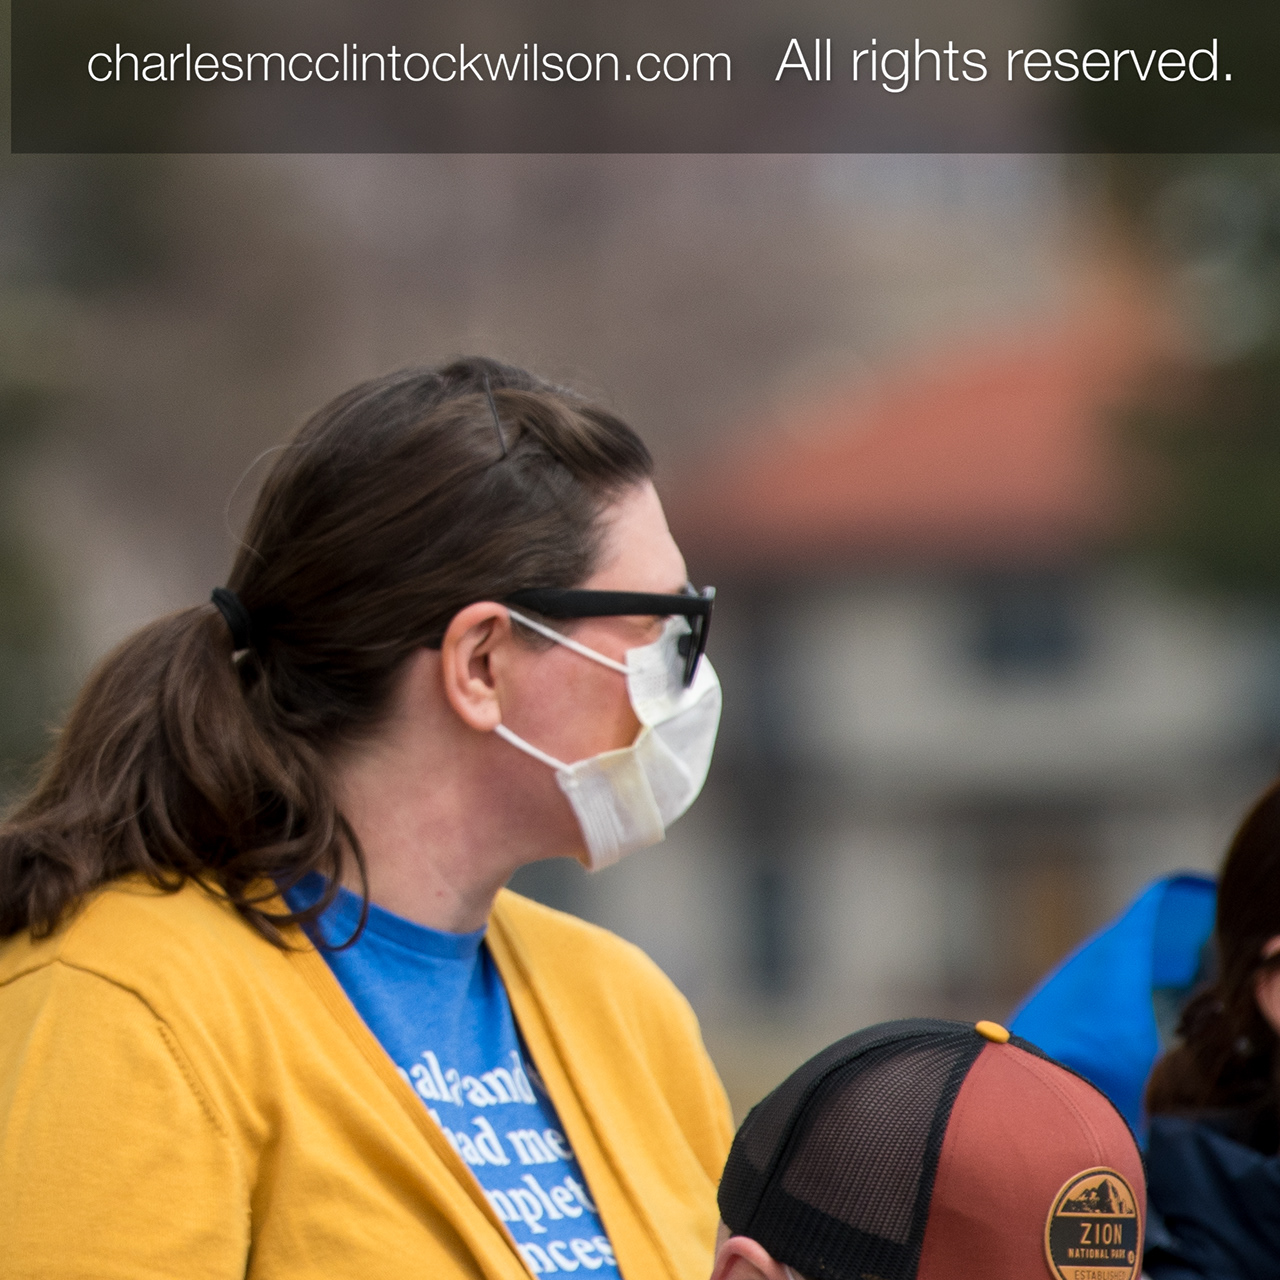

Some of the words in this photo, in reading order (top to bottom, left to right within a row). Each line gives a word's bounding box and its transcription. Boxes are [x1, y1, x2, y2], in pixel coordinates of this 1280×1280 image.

[461, 1049, 537, 1108] and
[1080, 1222, 1122, 1245] ZION
[1068, 1248, 1109, 1259] NATIONAL
[1111, 1249, 1126, 1259] PARK
